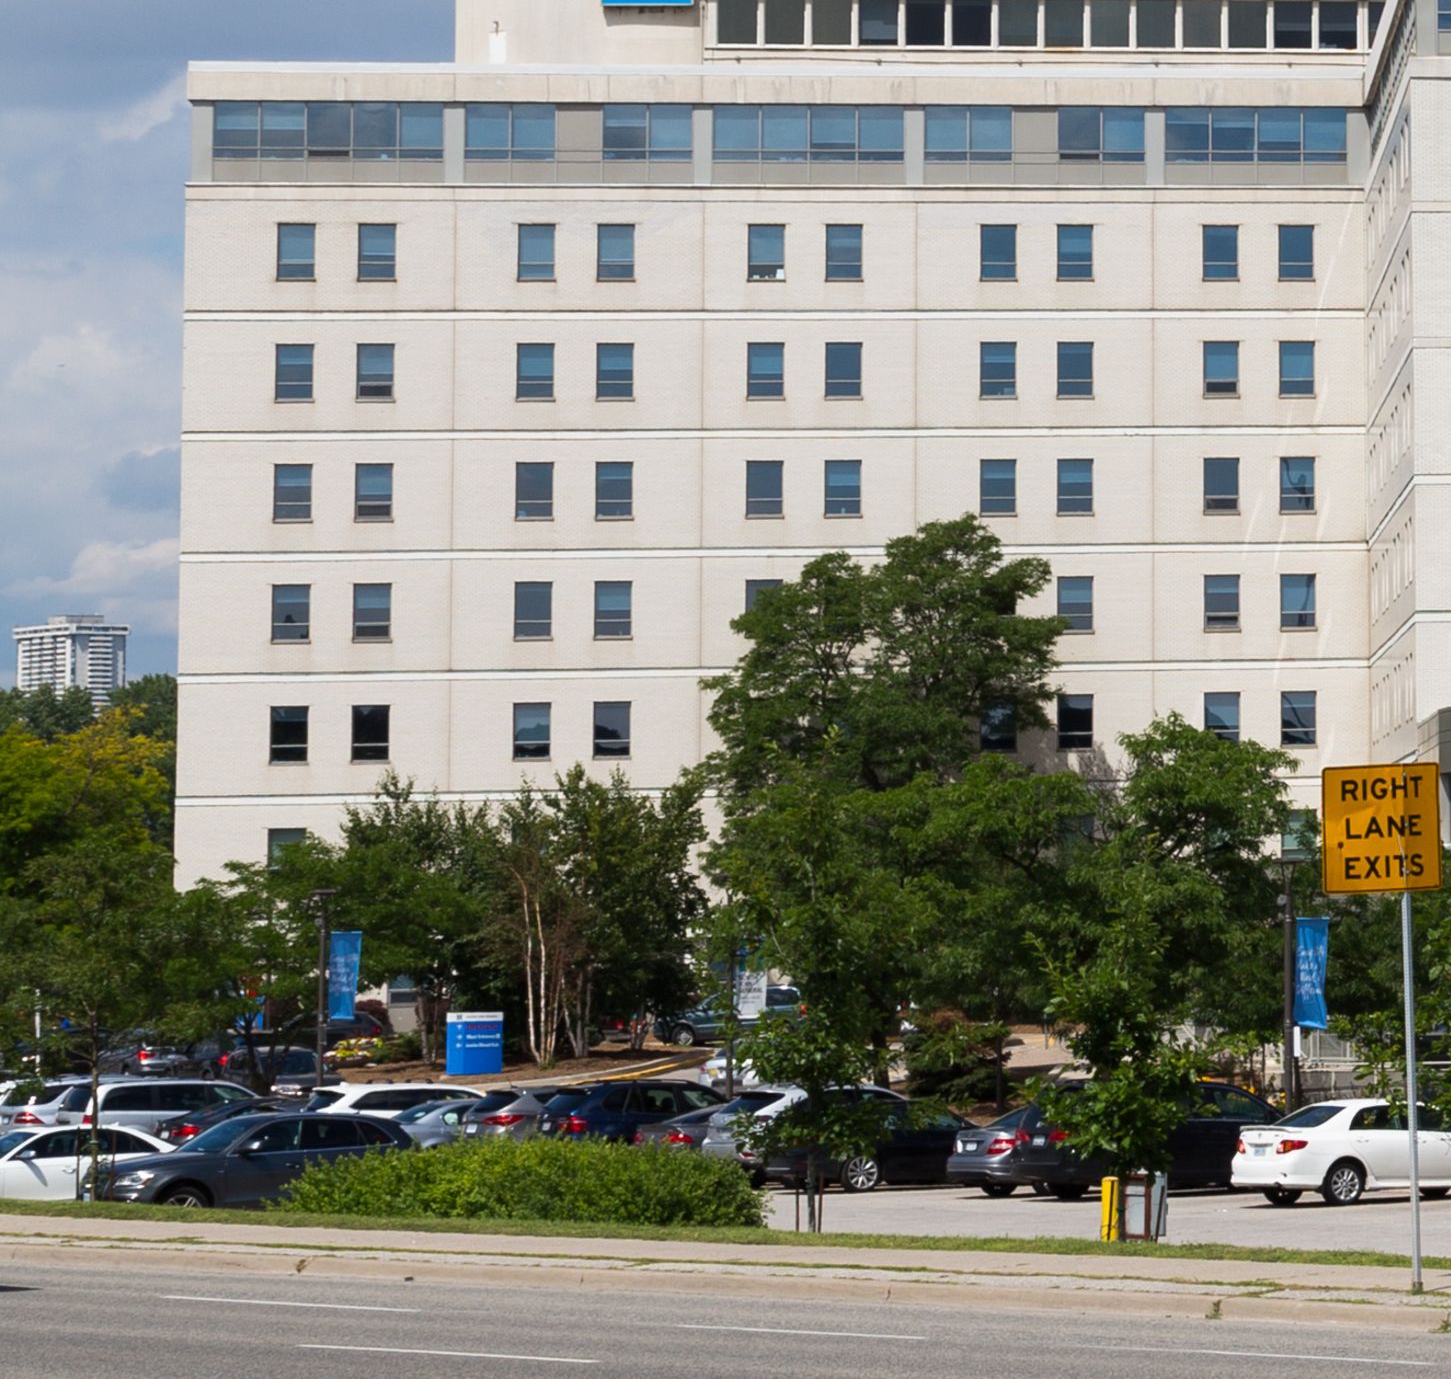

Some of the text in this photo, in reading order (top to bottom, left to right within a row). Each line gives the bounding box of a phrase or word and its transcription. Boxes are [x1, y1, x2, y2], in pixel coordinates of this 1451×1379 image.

[1340, 775, 1423, 802] RIGHT
[1345, 814, 1422, 840] LANE
[1344, 853, 1425, 880] EXITS
